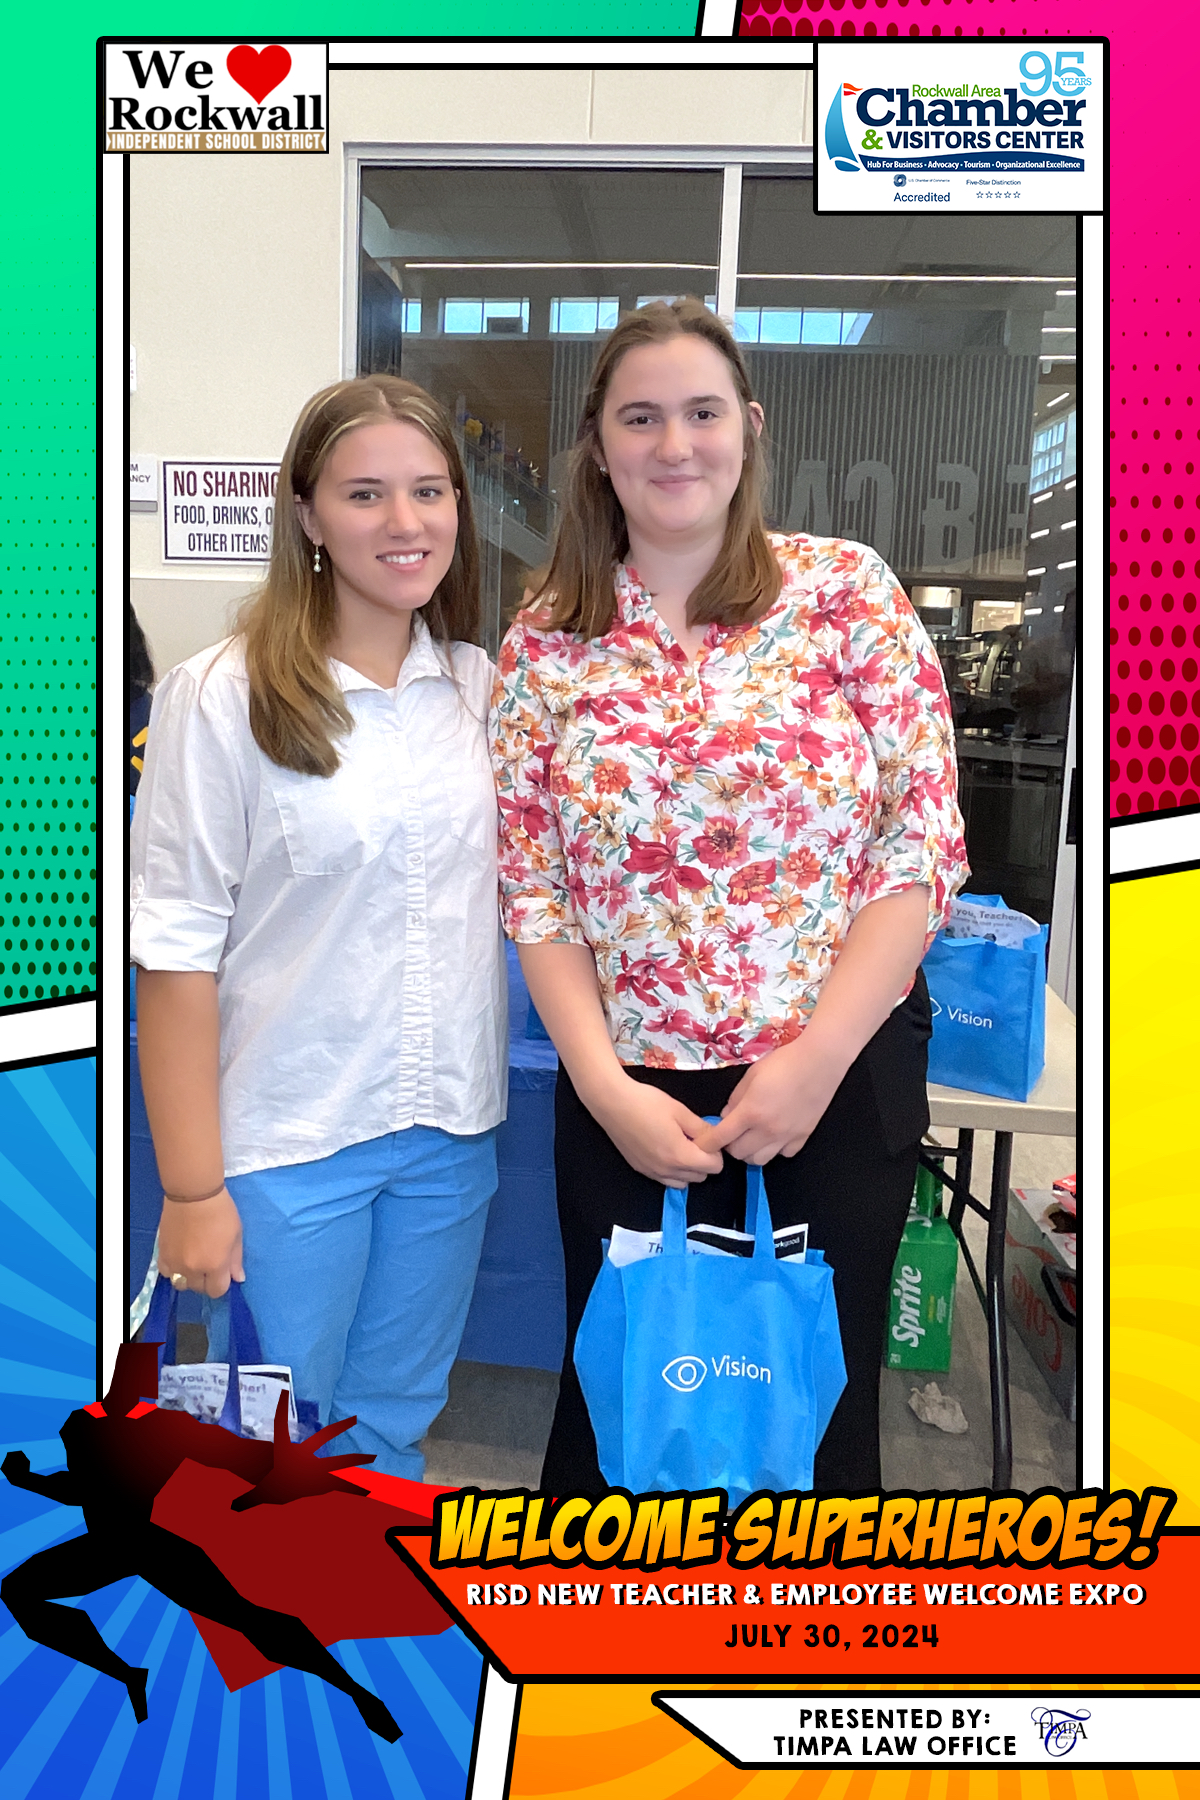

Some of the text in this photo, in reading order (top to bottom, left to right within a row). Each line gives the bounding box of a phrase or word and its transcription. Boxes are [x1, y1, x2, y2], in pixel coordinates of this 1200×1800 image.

[173, 470, 197, 497] NO
[174, 505, 273, 527] FOOD, DRINKS, O
[188, 532, 269, 553] OTHER ITEMS
[947, 1004, 993, 1029] Vision
[892, 1265, 926, 1348] Sprite
[711, 1354, 772, 1384] Vision
